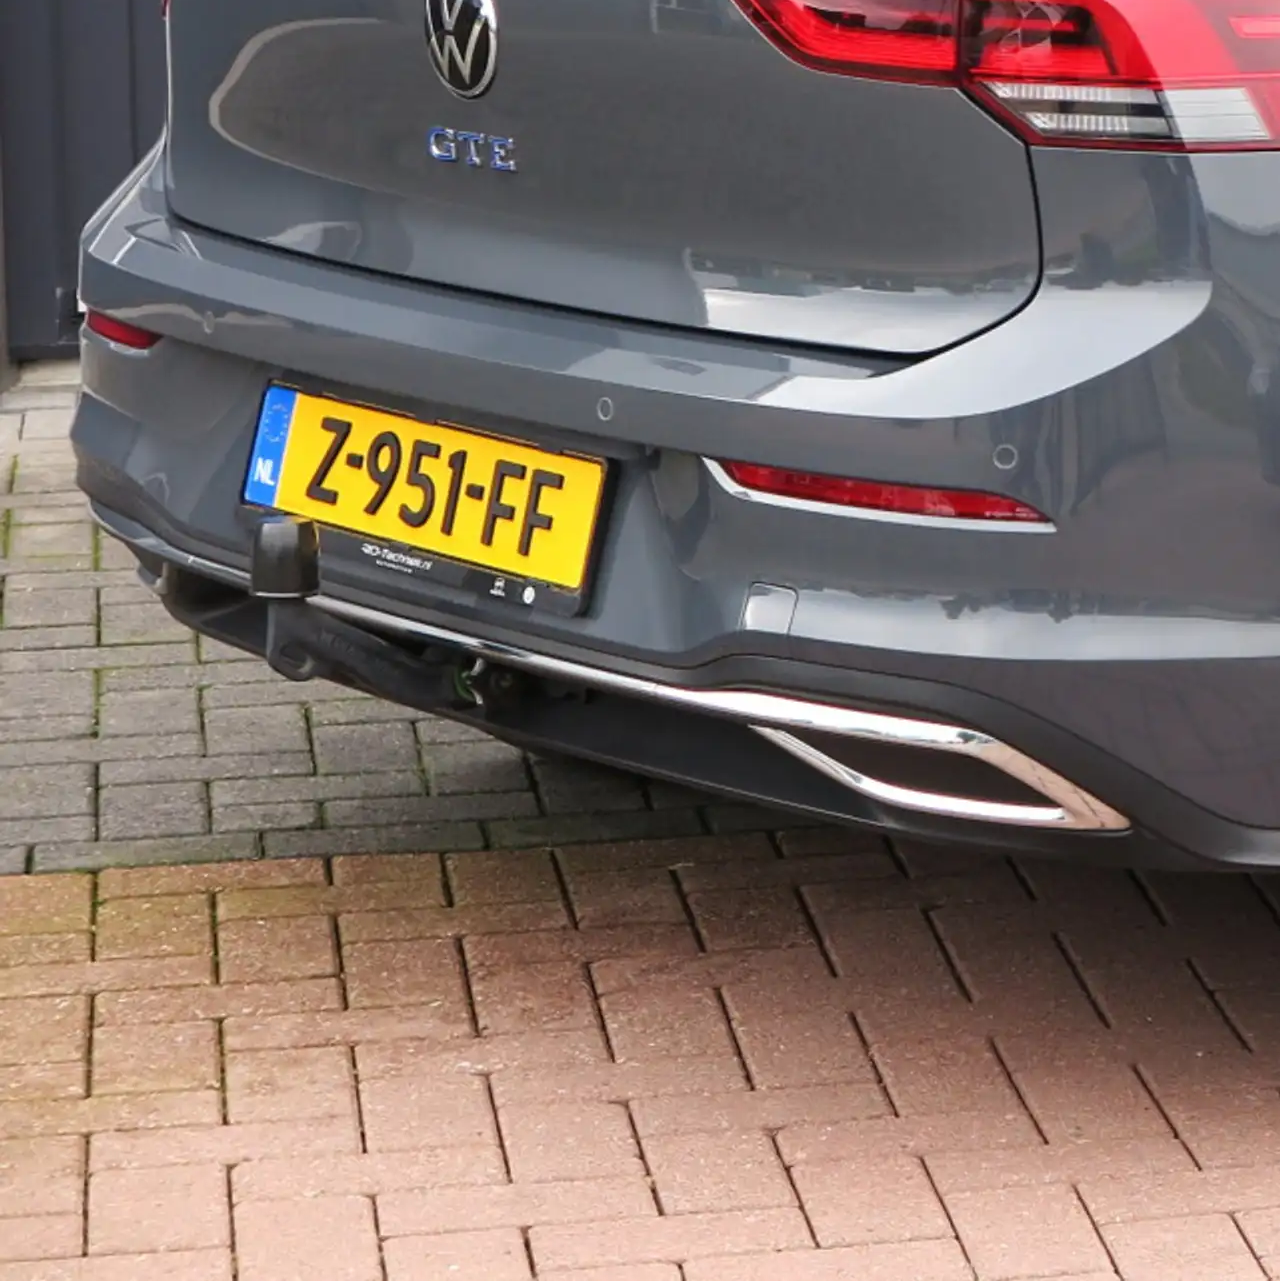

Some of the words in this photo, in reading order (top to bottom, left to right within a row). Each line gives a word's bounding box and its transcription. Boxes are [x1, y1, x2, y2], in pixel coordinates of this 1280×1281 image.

[427, 125, 518, 171] GTE
[253, 456, 276, 486] NL
[305, 416, 564, 557] Z-951-FF
